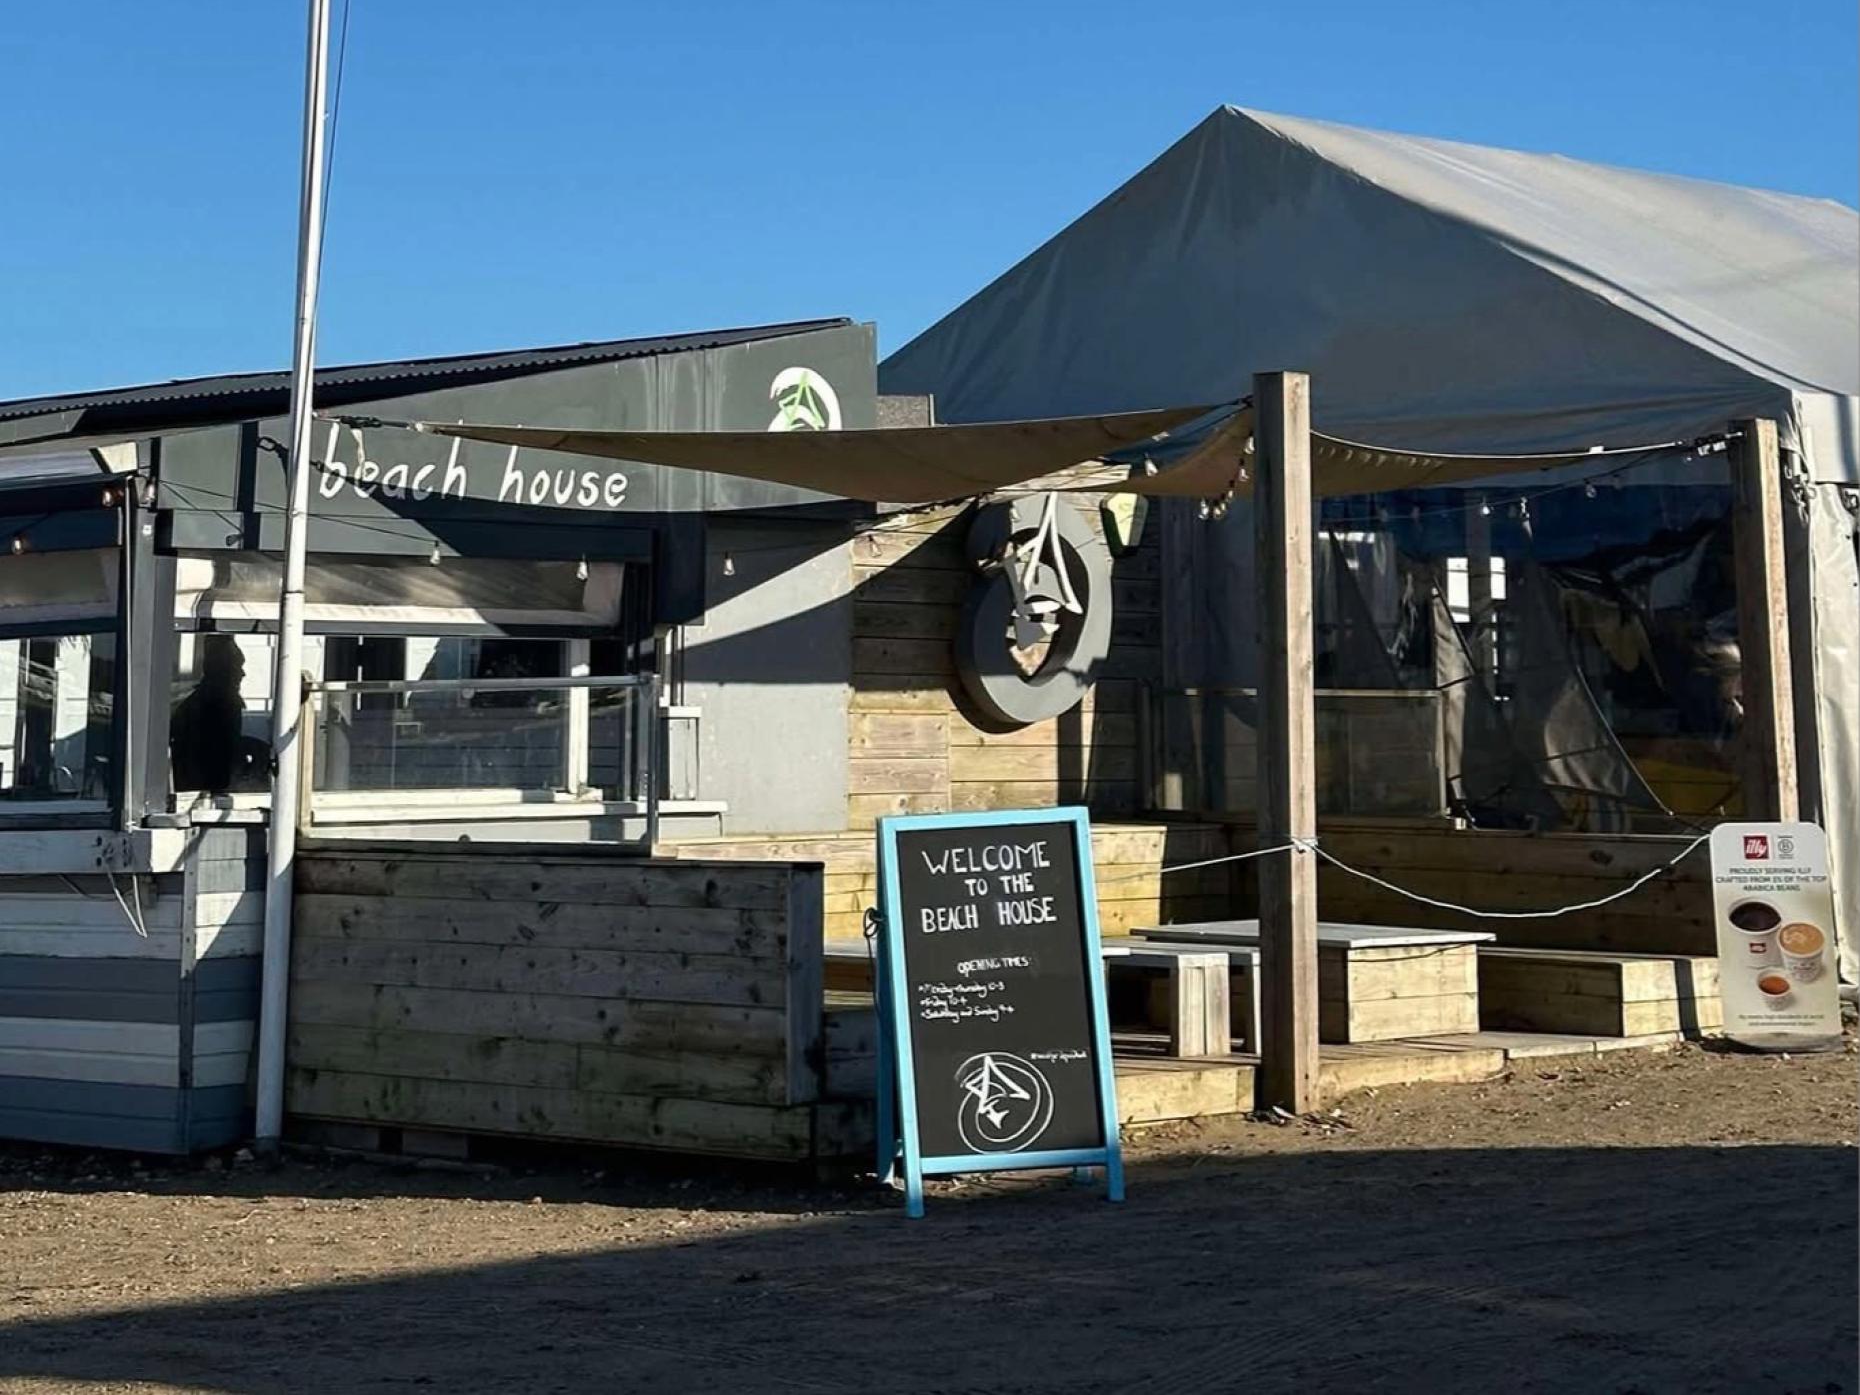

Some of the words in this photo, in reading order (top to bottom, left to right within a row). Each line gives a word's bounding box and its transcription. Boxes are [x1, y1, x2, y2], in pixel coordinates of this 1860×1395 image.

[319, 418, 467, 500] beach
[497, 424, 629, 507] house
[921, 840, 1051, 875] WELCOME
[1746, 838, 1768, 858] illy
[964, 878, 988, 896] TO
[998, 871, 1035, 894] THE
[920, 904, 979, 933] BEACH
[996, 896, 1057, 926] HOUSE
[957, 958, 1000, 977] OPENING
